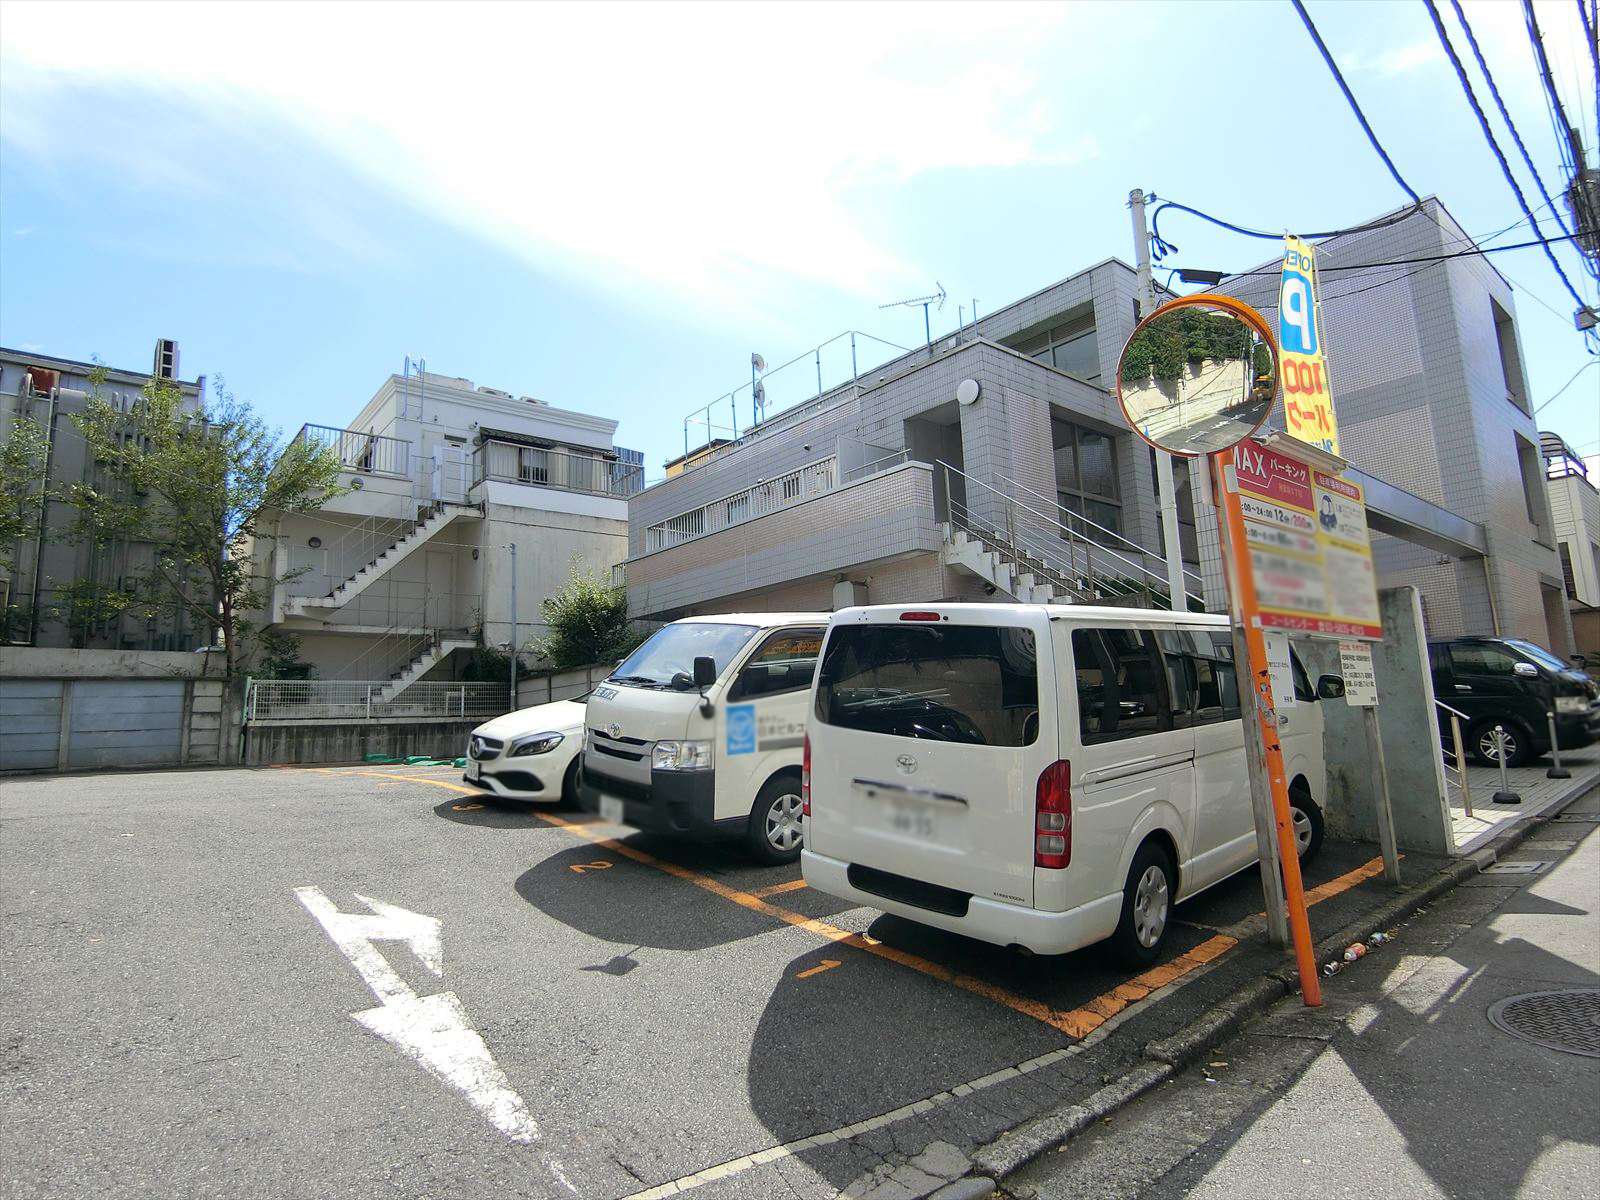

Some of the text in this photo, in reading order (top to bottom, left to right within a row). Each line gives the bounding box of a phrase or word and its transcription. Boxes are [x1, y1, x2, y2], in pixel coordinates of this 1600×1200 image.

[1270, 458, 1306, 482] パーキング
[1270, 615, 1314, 631] コールセンター
[569, 861, 614, 874] 2
[795, 959, 842, 981] 1
